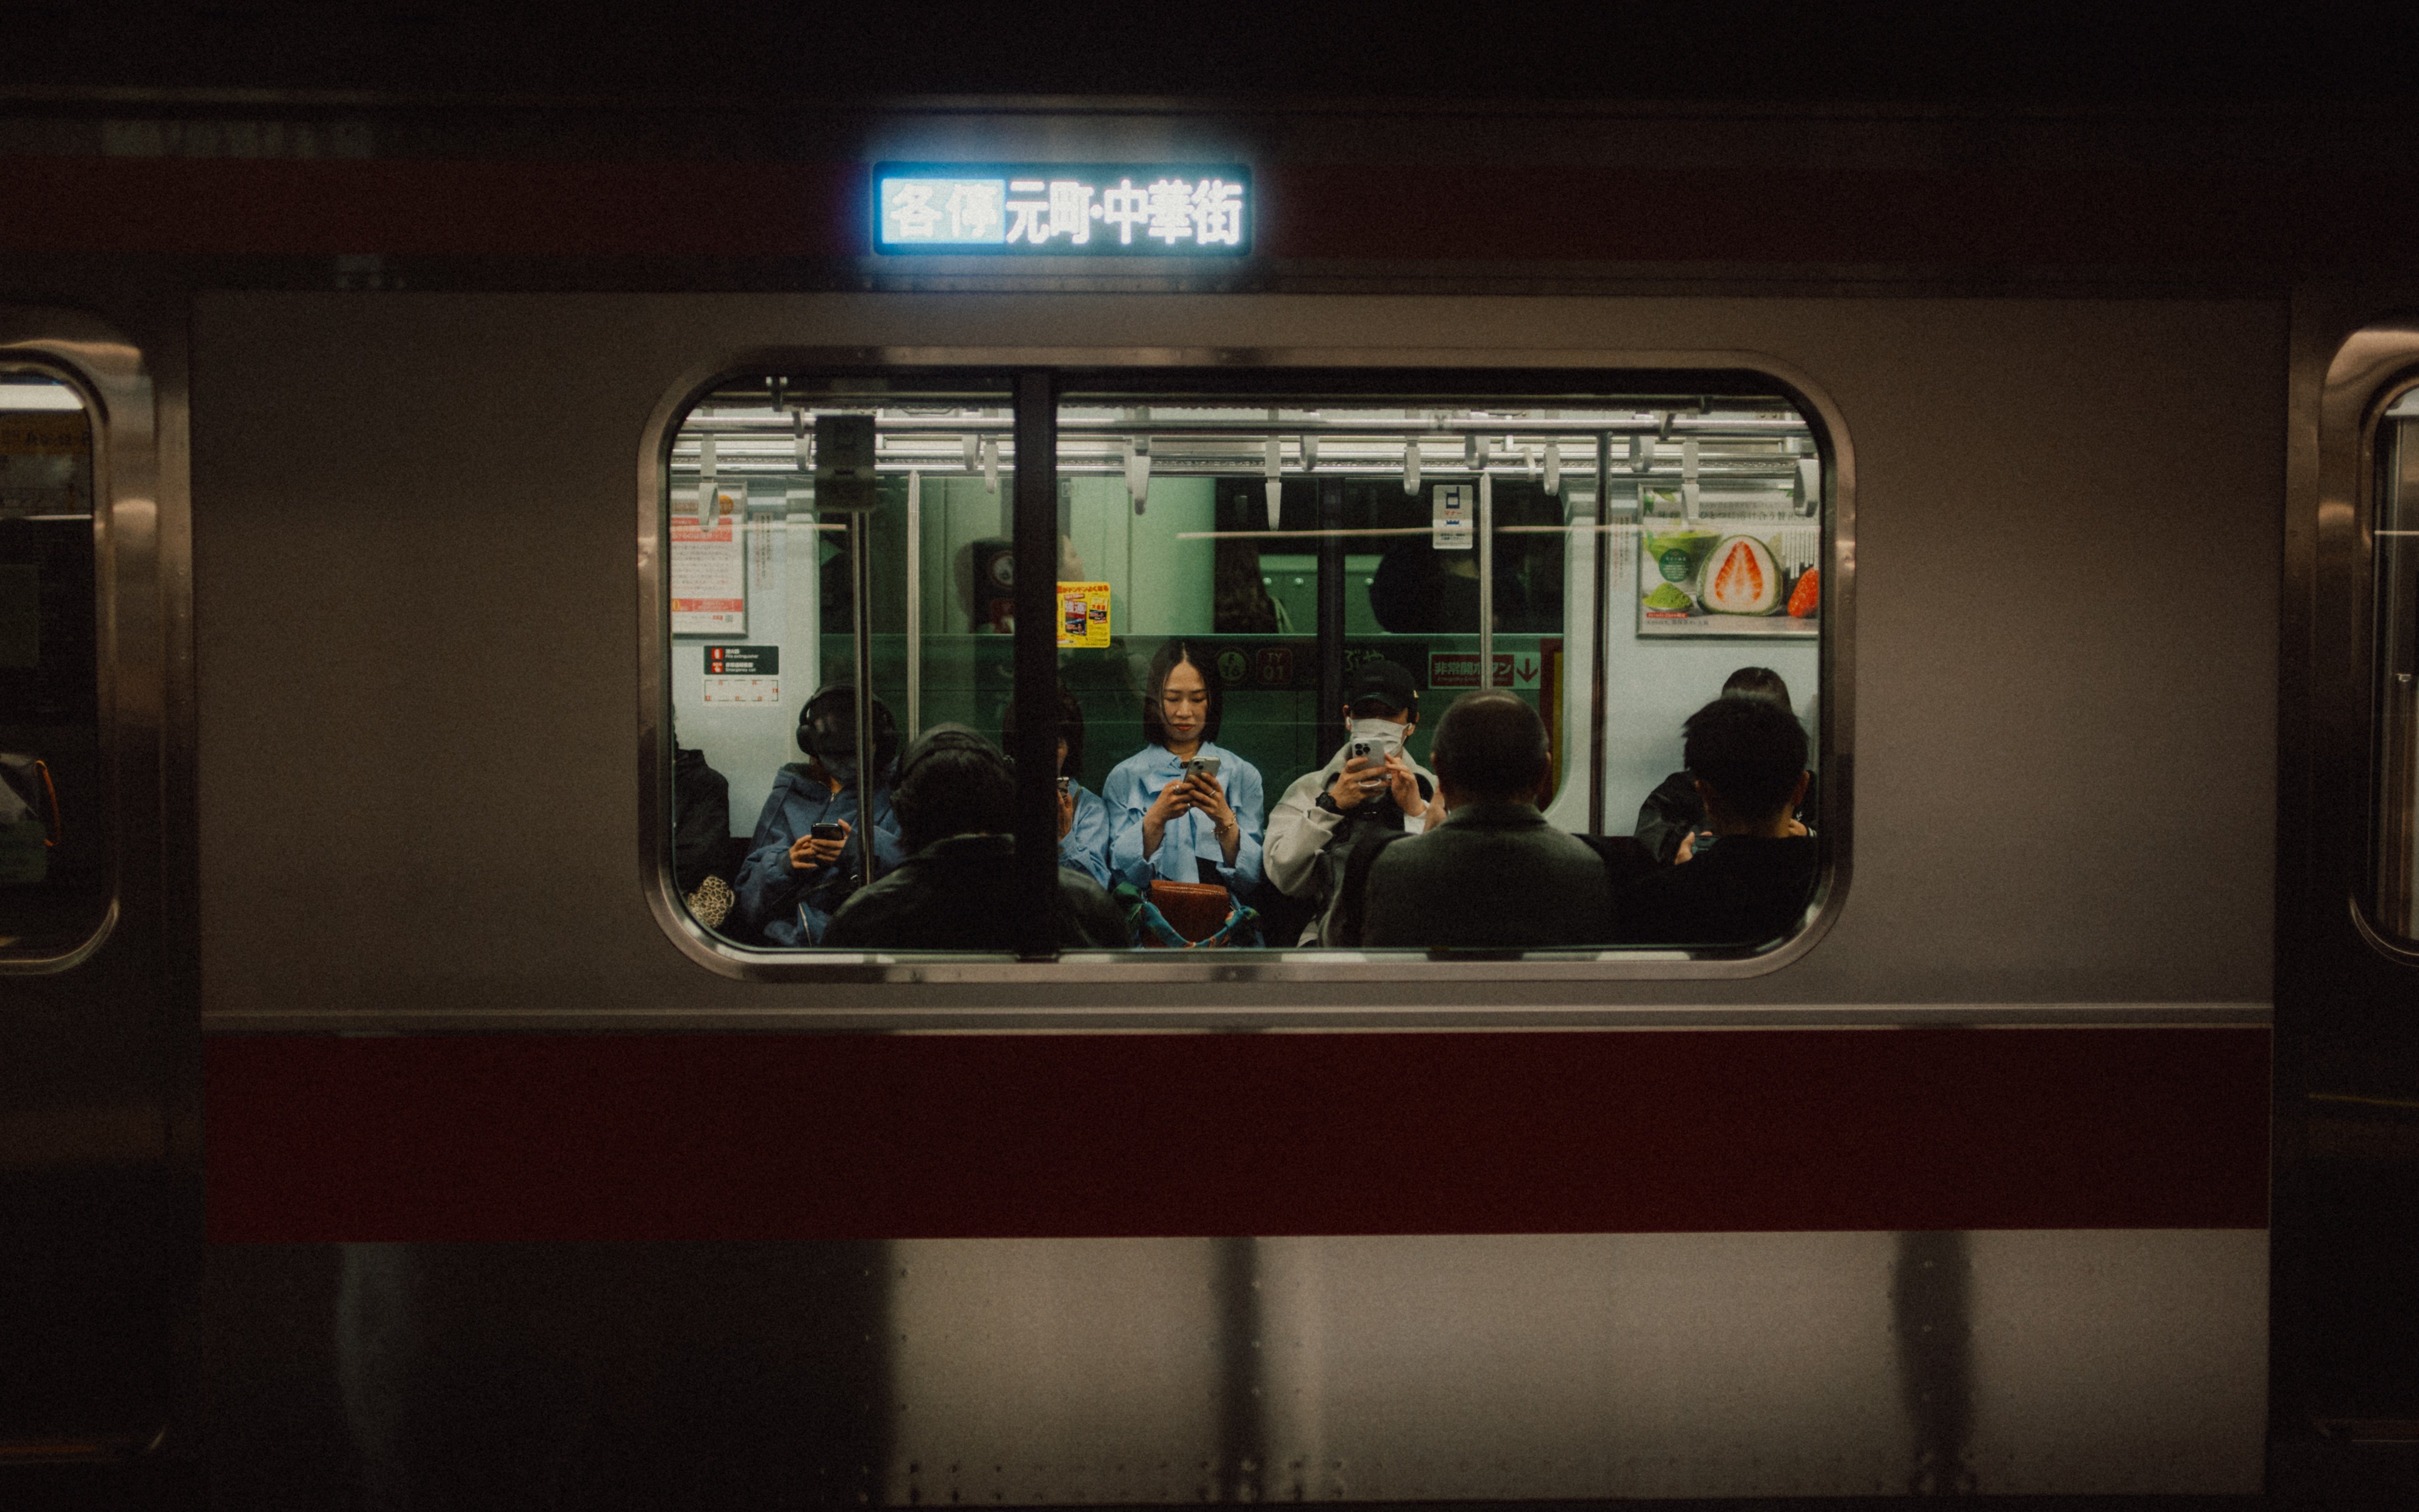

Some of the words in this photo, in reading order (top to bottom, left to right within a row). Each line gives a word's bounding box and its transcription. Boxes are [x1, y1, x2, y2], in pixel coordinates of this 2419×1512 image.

[890, 183, 999, 239] 各停
[1005, 179, 1243, 245] 元町・中華街
[1267, 653, 1283, 663] TY
[1343, 648, 1385, 671] ぶや
[1263, 666, 1284, 681] 01
